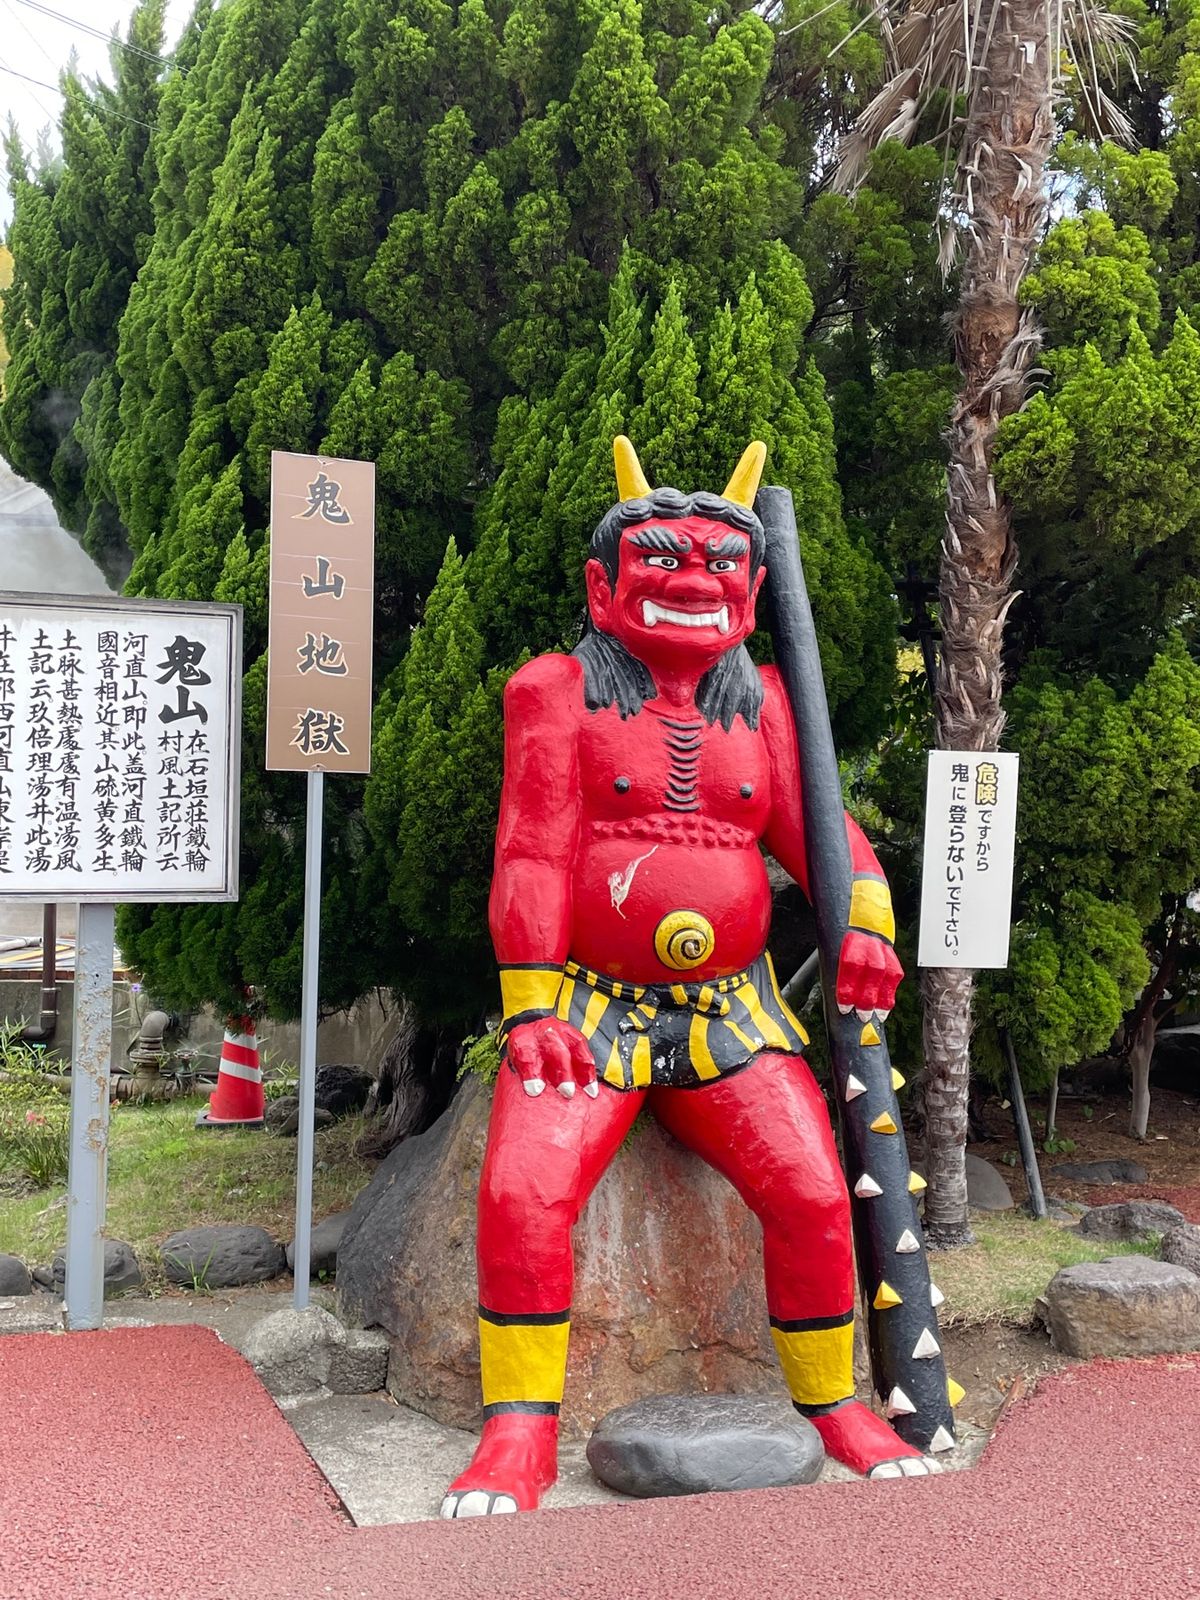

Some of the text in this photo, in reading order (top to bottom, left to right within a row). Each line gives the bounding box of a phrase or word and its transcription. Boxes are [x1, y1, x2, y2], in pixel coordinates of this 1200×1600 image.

[155, 635, 212, 726] 鬼山
[289, 473, 352, 755] 鬼山地獄
[944, 763, 970, 957] 鬼に登らないで下さい。
[975, 762, 998, 872] 危険ですから
